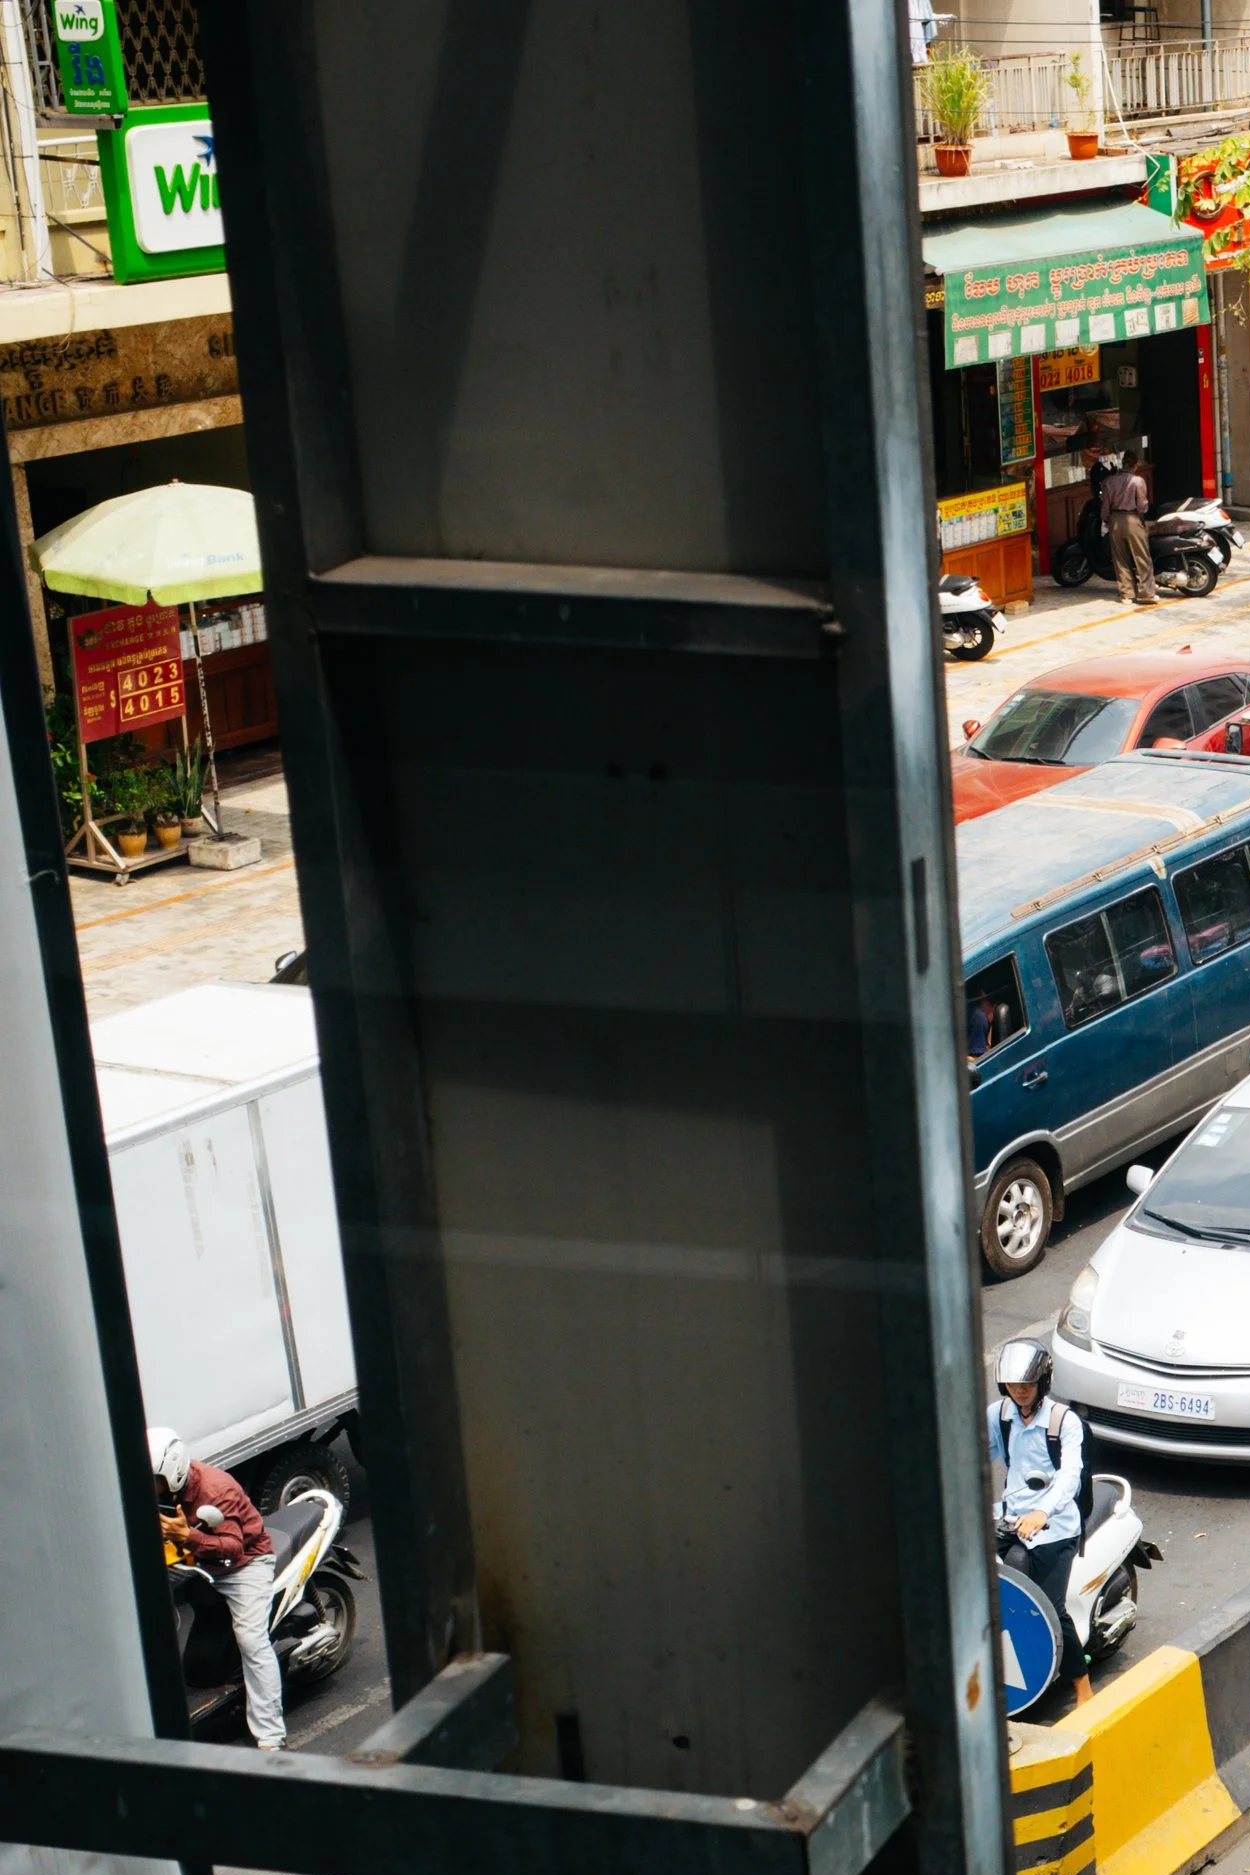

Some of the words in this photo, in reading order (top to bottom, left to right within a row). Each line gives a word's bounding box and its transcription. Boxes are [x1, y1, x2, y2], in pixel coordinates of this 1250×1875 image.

[60, 13, 98, 36] Wing
[1065, 365, 1093, 382] 4018
[206, 552, 245, 566] Bank
[123, 662, 179, 691] 4023
[124, 686, 180, 715] 4015
[1153, 1392, 1210, 1416] 2BS-6494
